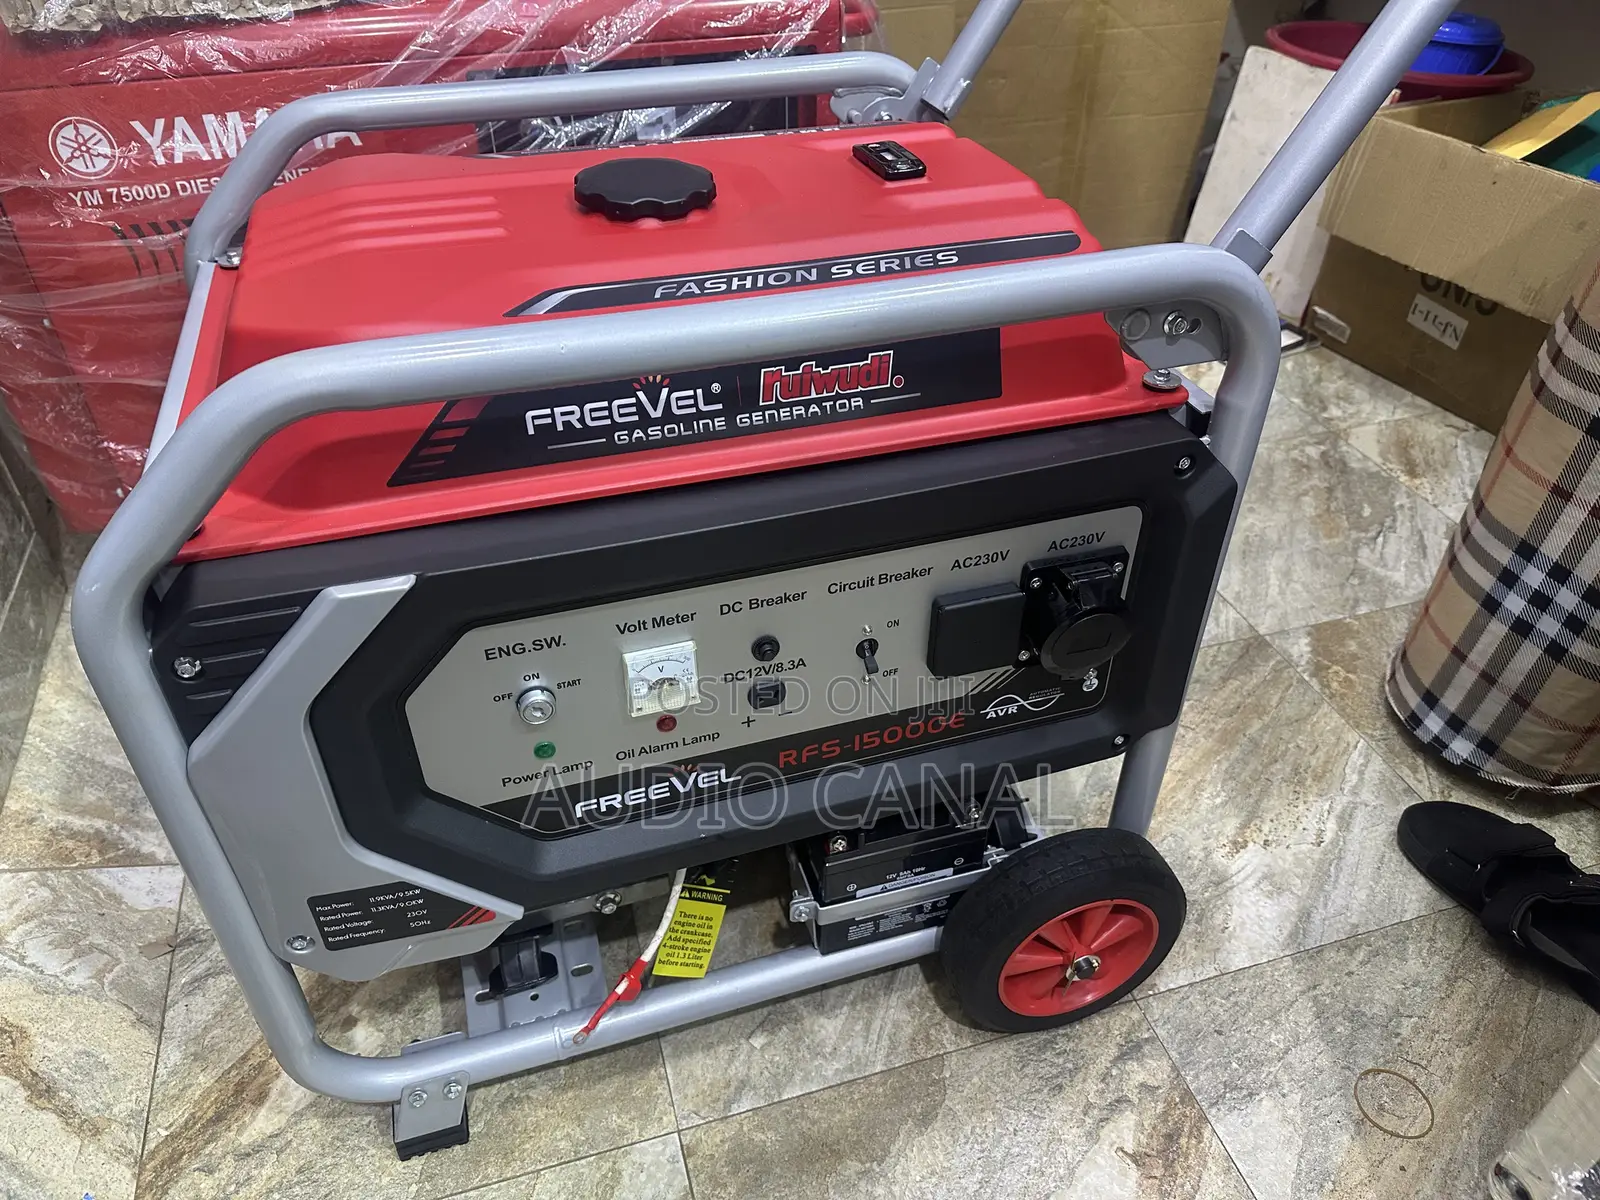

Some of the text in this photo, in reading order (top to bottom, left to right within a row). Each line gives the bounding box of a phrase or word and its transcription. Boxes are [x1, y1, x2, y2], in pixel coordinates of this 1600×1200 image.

[68, 189, 104, 206] YM
[106, 182, 171, 203] 7500D
[653, 251, 959, 299] FASHION SERIES
[614, 397, 864, 445] GASOLINE GENERATOR
[1047, 531, 1106, 553] AC230V
[950, 549, 1010, 571] AC230V
[827, 565, 934, 595] Circuit Breaker
[719, 590, 808, 616] DC Breaker
[615, 610, 697, 635] Volt Meter
[887, 619, 900, 628] ON
[484, 635, 567, 661] ENG.SW.
[523, 672, 540, 682] ON
[723, 657, 807, 684] DC12V/8.3A
[883, 668, 898, 677] OFF
[556, 678, 582, 690] START
[493, 693, 513, 703] OFF
[986, 706, 1018, 720] AVR
[615, 731, 721, 761] Oil Alarm Lamp
[501, 759, 594, 787] Power Lamp
[575, 768, 742, 818] FREEVEL
[369, 888, 421, 903] 11.9KVA/9.5KW
[691, 890, 723, 901] WARNING
[320, 913, 341, 922] Rated
[341, 910, 364, 919] Power:
[324, 909, 428, 932] Rated Voltage: 230V
[679, 911, 697, 920] There
[328, 934, 349, 942] Rated
[409, 920, 431, 928] 50Hz
[674, 920, 696, 929] engine
[697, 921, 705, 929] oil
[680, 928, 714, 938] crankcase.
[662, 942, 711, 954] 4-stroke engine
[682, 937, 711, 946] specified
[658, 958, 679, 967] before
[676, 952, 686, 960] 1.3
[687, 953, 703, 961] Liter
